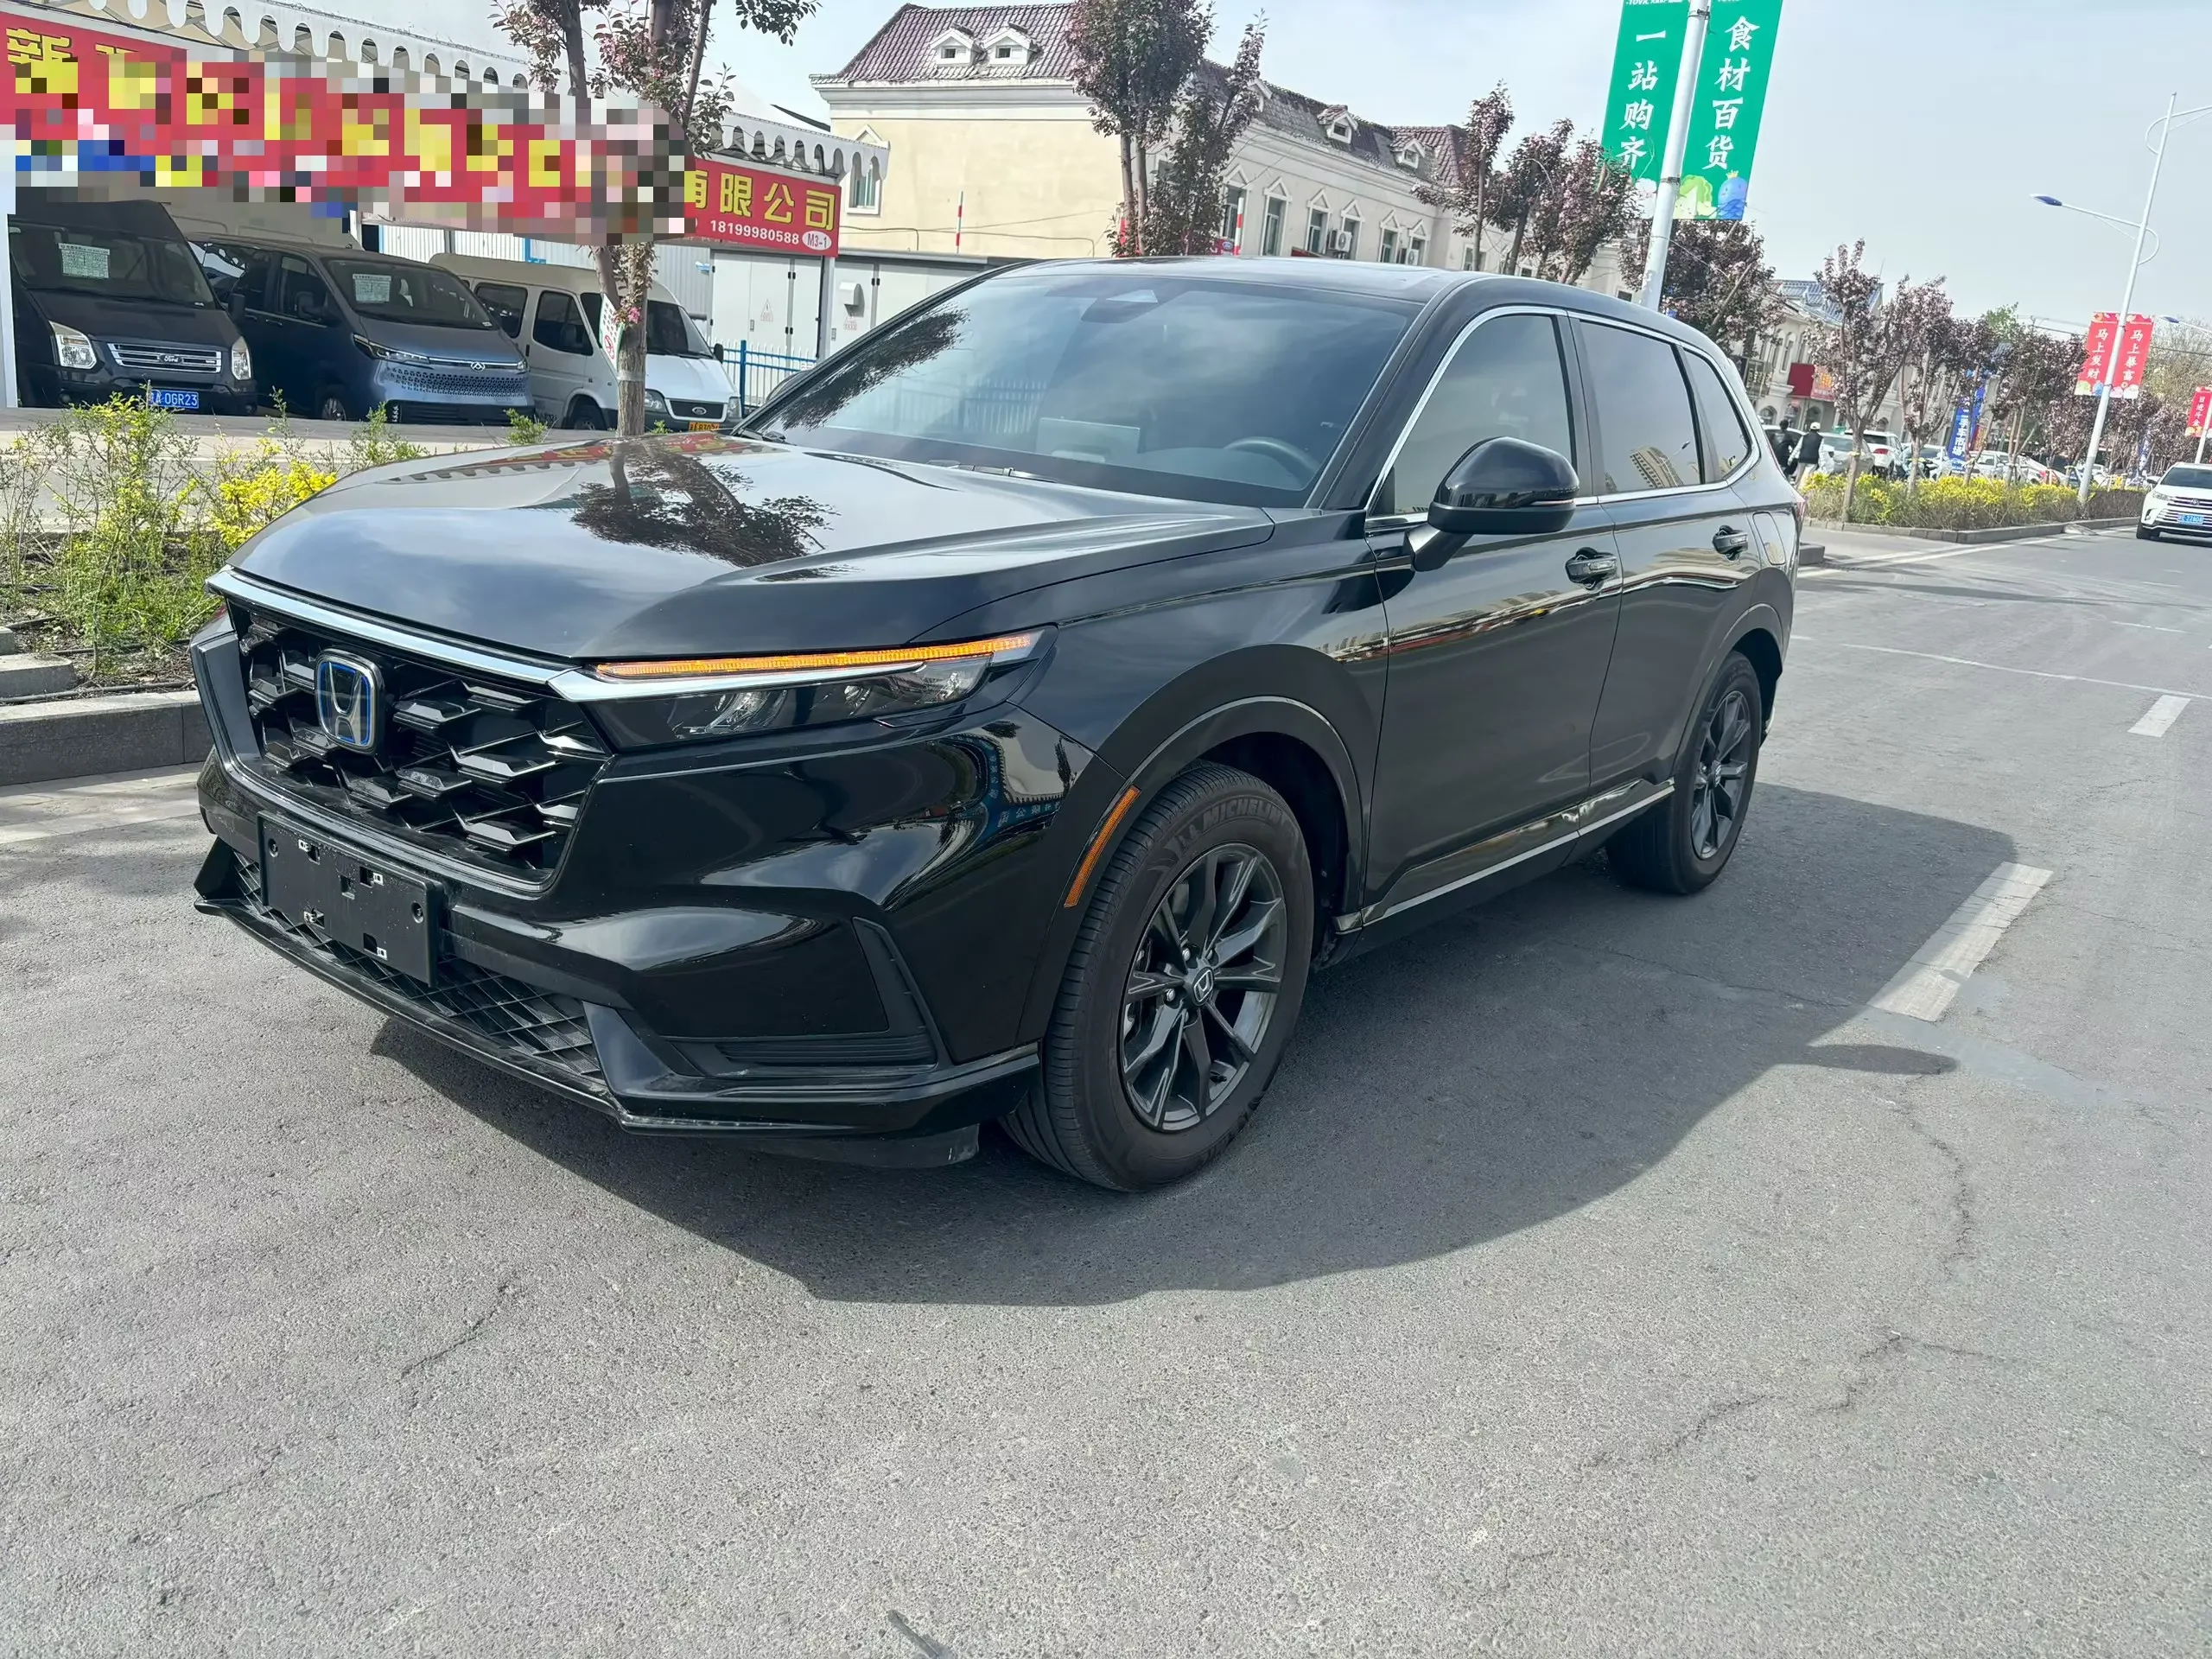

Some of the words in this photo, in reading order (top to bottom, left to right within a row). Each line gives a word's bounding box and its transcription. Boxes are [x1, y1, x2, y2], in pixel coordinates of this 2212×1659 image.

[1615, 30, 1667, 170] 一站购齐
[1701, 16, 1761, 170] 食材百货
[710, 219, 799, 245] 18199980588
[807, 232, 829, 248] M3-1
[2087, 327, 2108, 380] 马上发财
[2122, 329, 2144, 381] 马上暴富
[1202, 797, 1289, 831] MICHELIN
